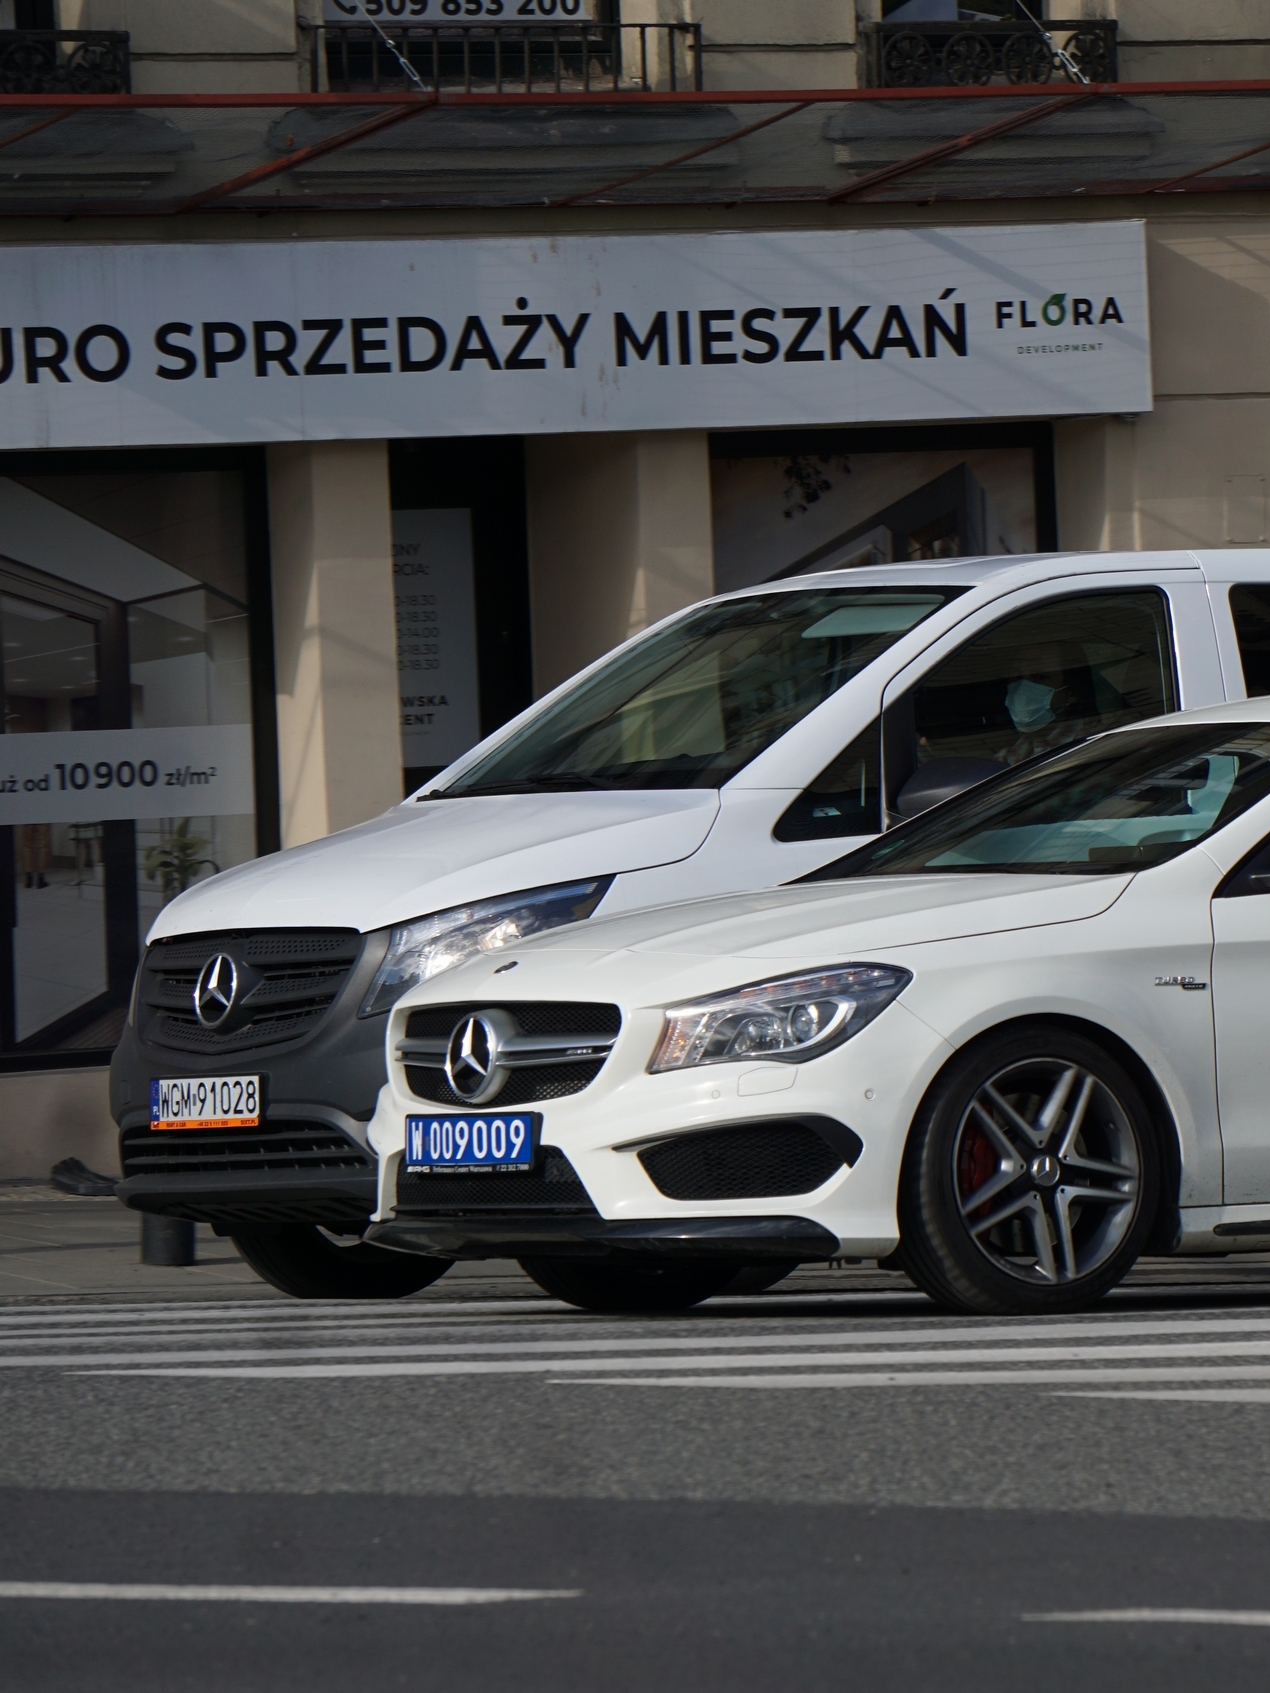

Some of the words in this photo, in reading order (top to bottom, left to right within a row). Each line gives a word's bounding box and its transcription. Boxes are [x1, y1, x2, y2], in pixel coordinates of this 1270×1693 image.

[995, 293, 1124, 329] FLORA
[155, 296, 591, 381] SPRZEDAŻY
[614, 288, 968, 367] MIESZKAŃ
[1017, 343, 1104, 355] DEVELOPMENT
[23, 774, 49, 792] od
[1154, 976, 1195, 985] TURBO
[161, 1082, 191, 1118] WGM
[197, 1080, 257, 1116] 91028
[411, 1121, 423, 1160] W
[430, 1119, 525, 1160] 009009
